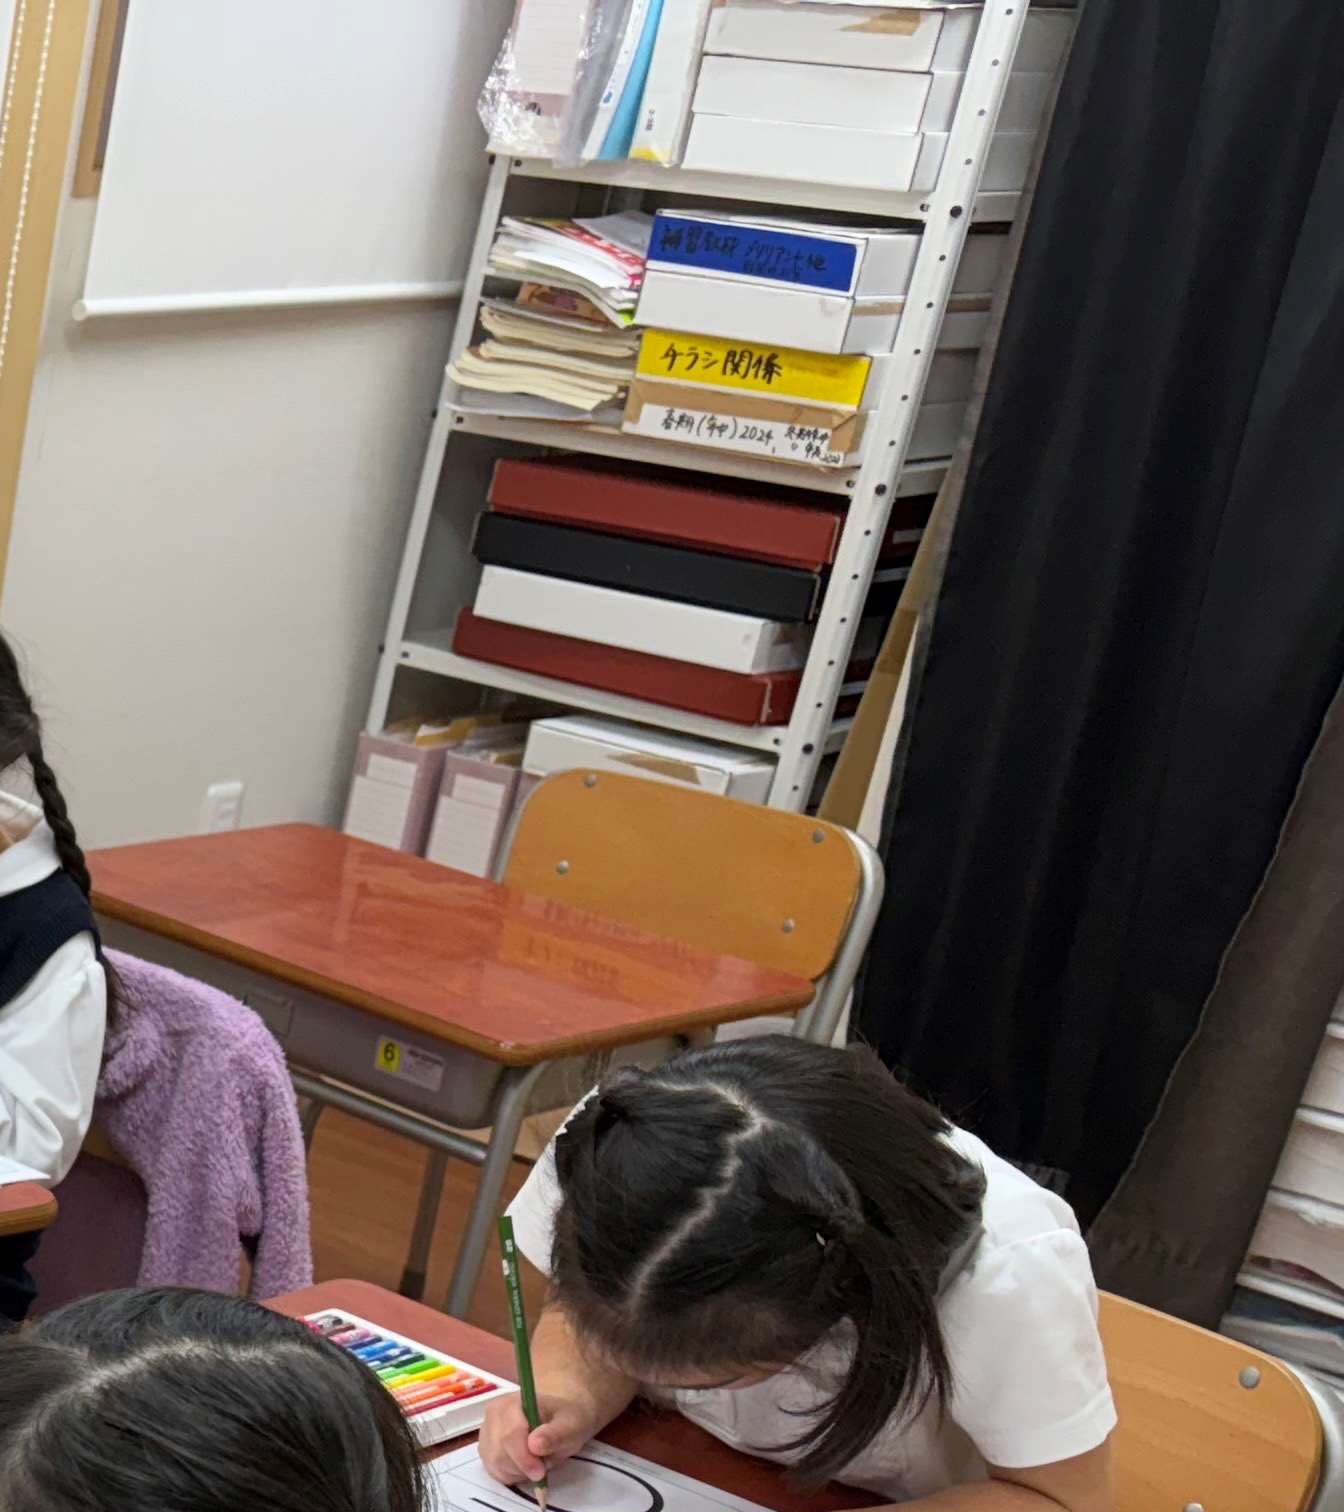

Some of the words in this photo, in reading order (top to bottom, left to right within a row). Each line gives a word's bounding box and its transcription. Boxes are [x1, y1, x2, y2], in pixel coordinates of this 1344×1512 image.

[660, 342, 783, 385] チラシ関係
